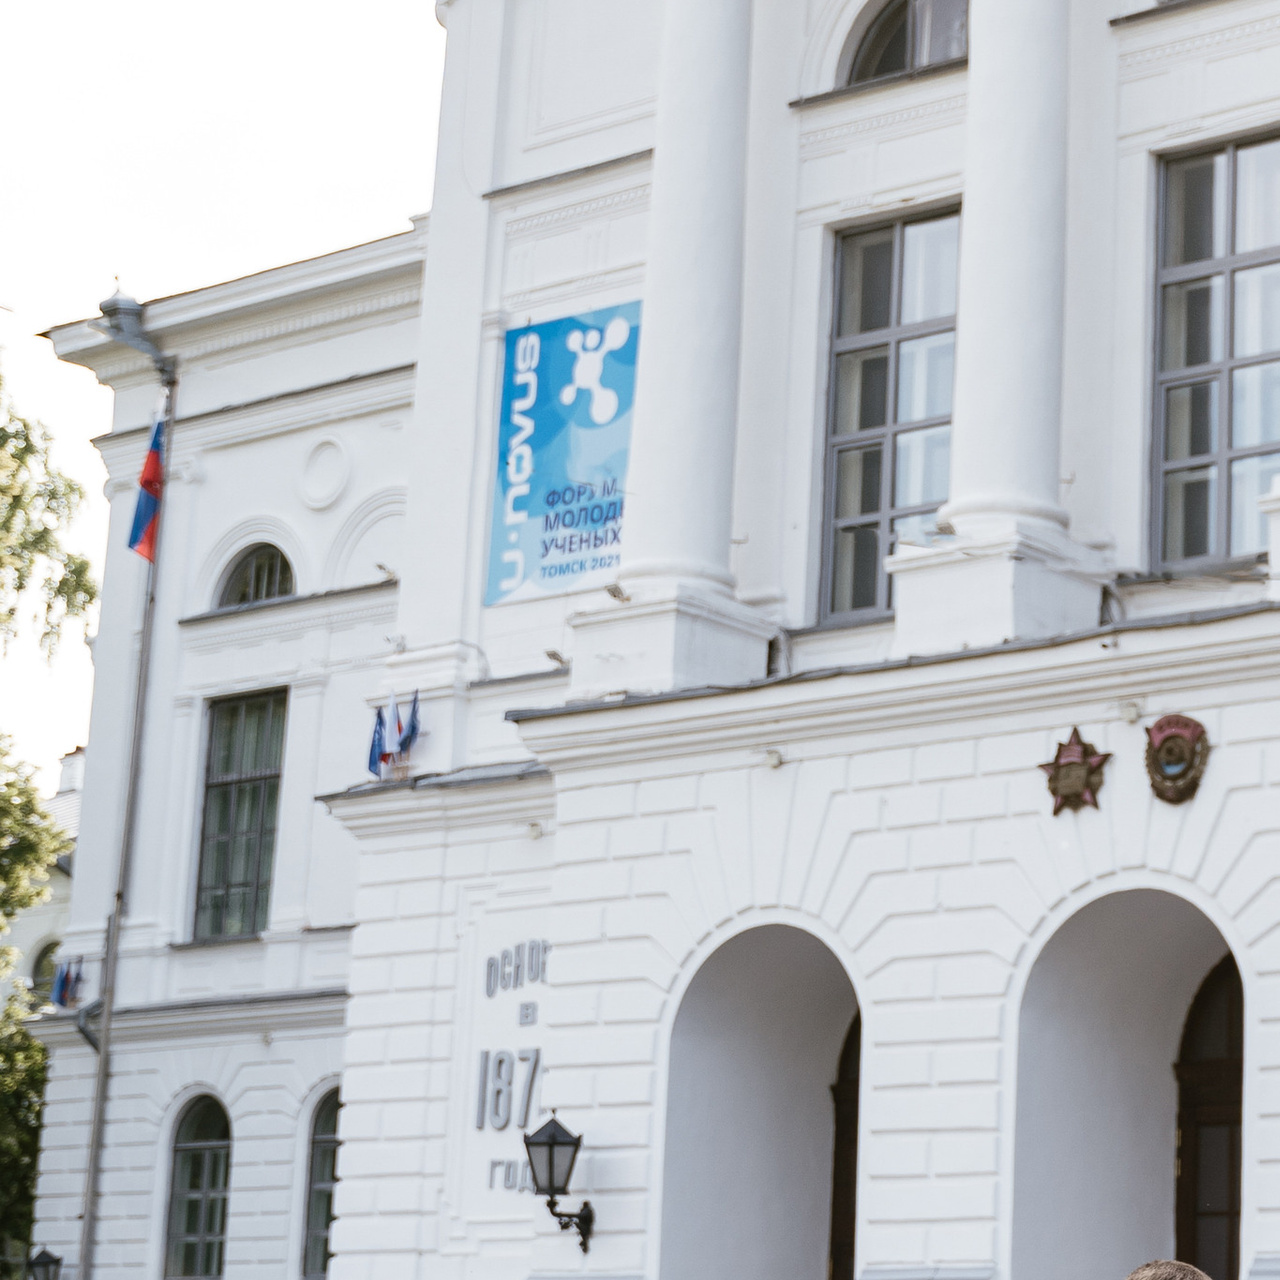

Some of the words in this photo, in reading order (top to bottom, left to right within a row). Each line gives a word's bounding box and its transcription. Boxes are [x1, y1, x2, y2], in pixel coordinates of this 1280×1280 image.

[544, 499, 624, 533] МОЛОД
[541, 526, 622, 559] УЧЕНЫХ
[541, 559, 588, 578] ТОМСК
[519, 1002, 538, 1025] В
[476, 1047, 549, 1130] 187
